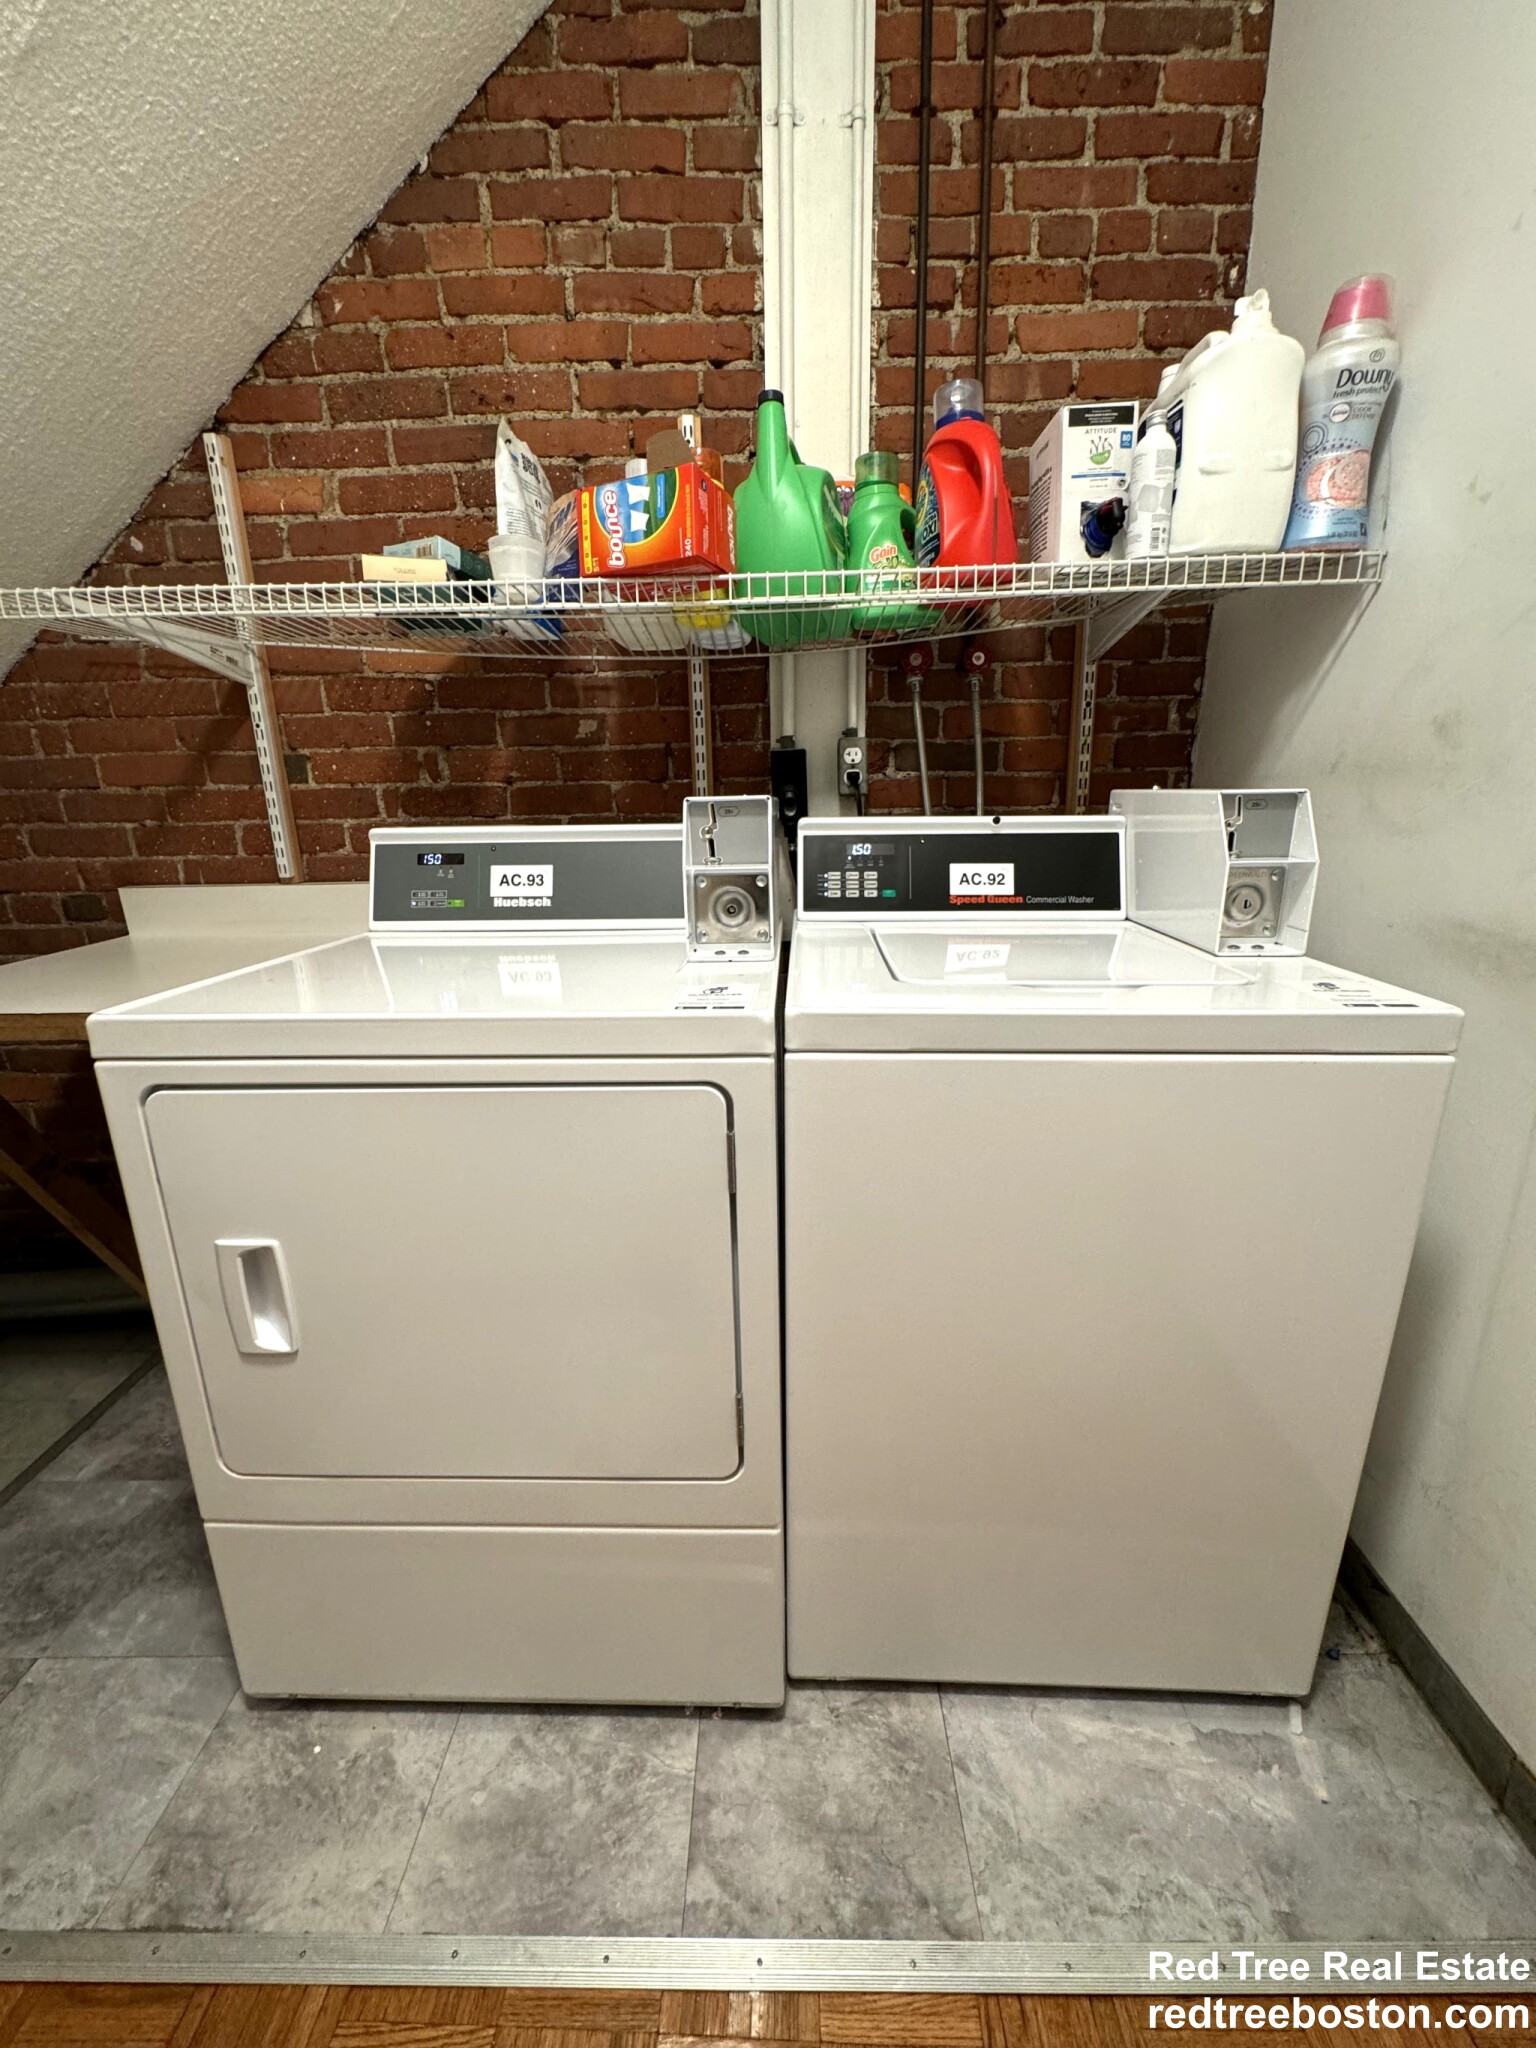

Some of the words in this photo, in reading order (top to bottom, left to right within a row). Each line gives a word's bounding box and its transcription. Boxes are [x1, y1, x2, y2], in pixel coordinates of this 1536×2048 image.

[1336, 368, 1395, 392] Downy
[1333, 387, 1355, 399] fresh
[1356, 386, 1383, 397] protect
[1084, 427, 1117, 435] ATTITUDE
[604, 489, 625, 568] bounce
[922, 520, 937, 541] OXI
[869, 545, 898, 563] Gain
[499, 873, 545, 887] AC.93
[959, 872, 1006, 886] AC.92
[493, 896, 552, 908] Huebsch
[949, 895, 986, 905] Speed
[987, 895, 1024, 904] Queen
[1025, 895, 1067, 904] Commercial
[1068, 895, 1095, 904] Washer
